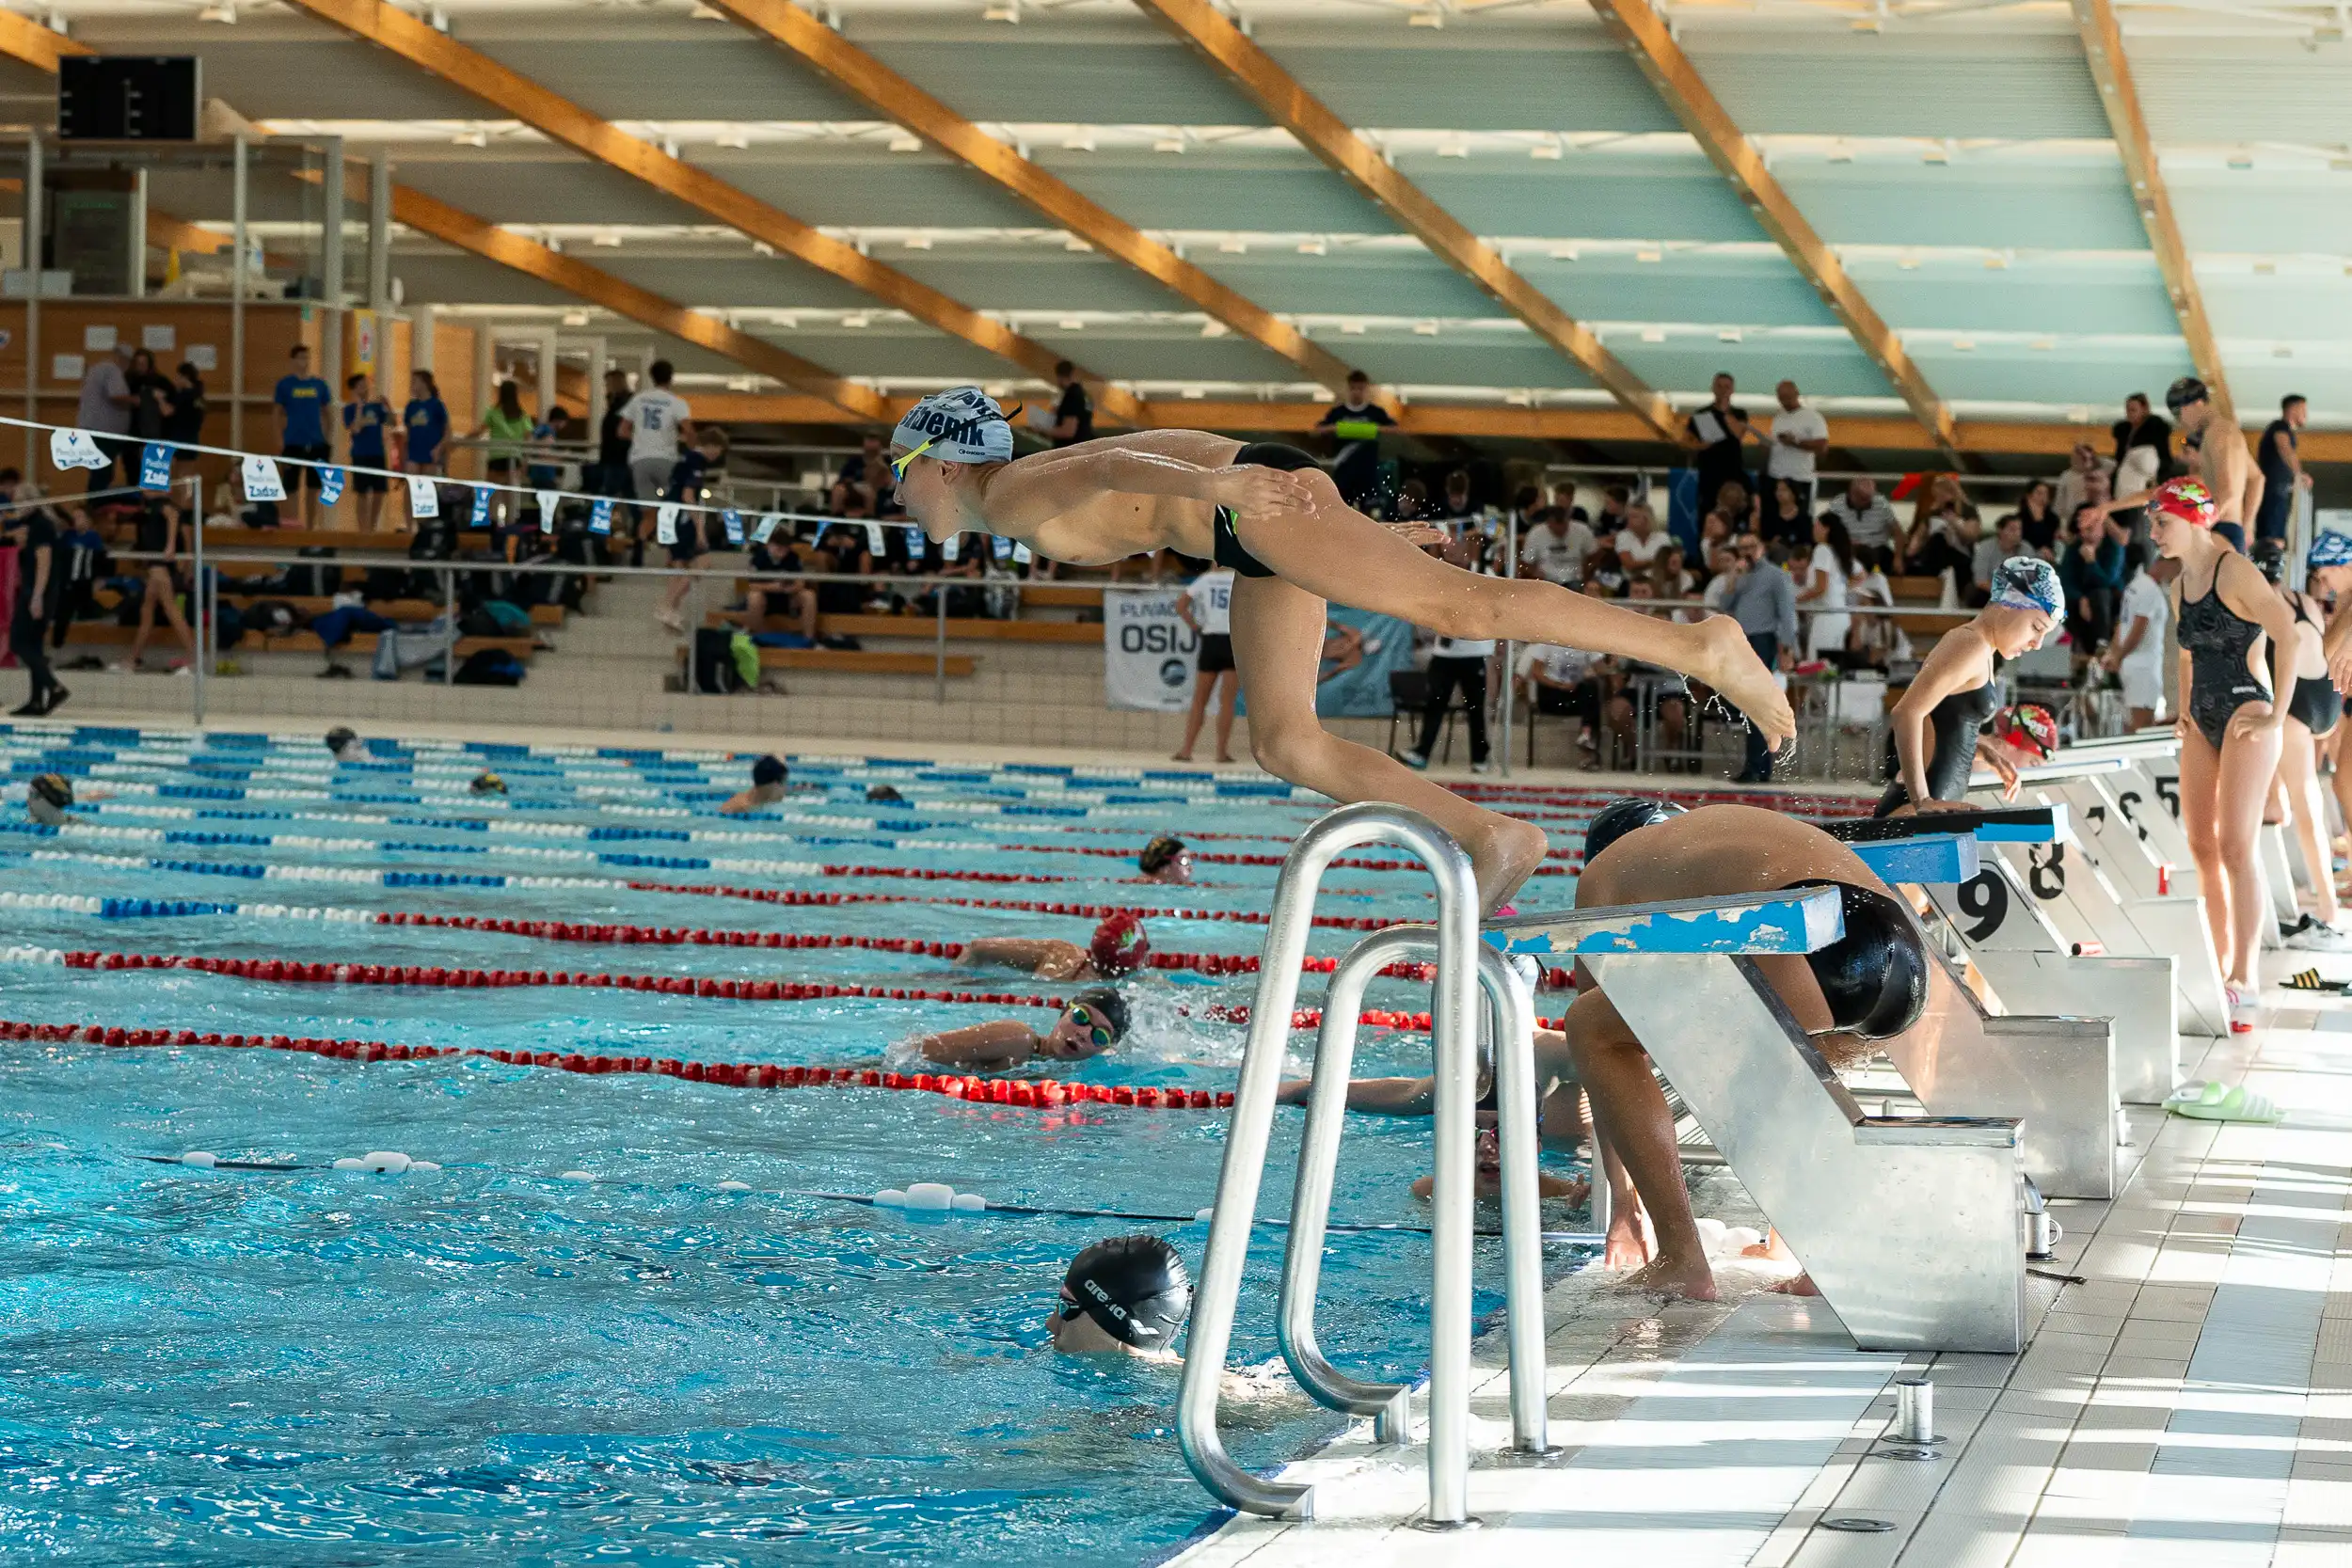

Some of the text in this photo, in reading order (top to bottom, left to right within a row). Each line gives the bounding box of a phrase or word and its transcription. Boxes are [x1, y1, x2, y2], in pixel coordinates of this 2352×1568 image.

[248, 485, 279, 498] Zadar
[1210, 587, 1229, 610] 15
[1957, 868, 2009, 942] 9
